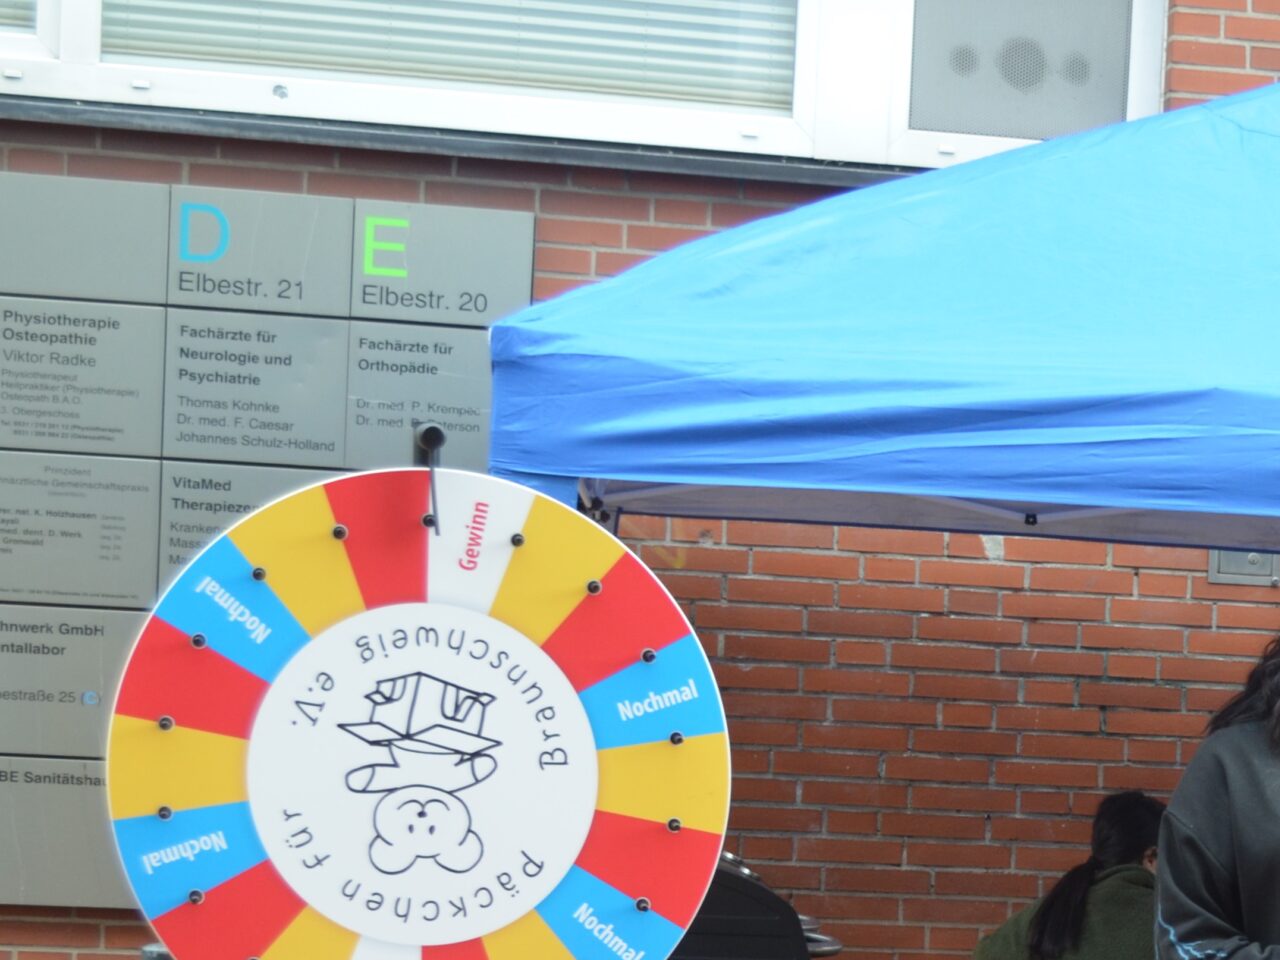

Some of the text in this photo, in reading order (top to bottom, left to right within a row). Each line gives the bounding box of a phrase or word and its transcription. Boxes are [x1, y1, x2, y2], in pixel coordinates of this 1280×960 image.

[179, 201, 231, 263] D
[363, 215, 410, 278] E
[178, 270, 304, 301] Elbestr. 21
[361, 284, 488, 313] Elbestr. 20
[2, 309, 121, 330] Physiotherapie
[2, 327, 98, 346] Osteopathie
[179, 324, 278, 344] Fachärzte für
[358, 337, 455, 355] Fachärzte für
[2, 349, 97, 367] Viktor Radke
[178, 347, 293, 366] Neurologie und
[358, 358, 439, 376] Orthopädie
[178, 368, 261, 386] Psychiatrie
[177, 394, 280, 413] Thomas Kohnke
[356, 398, 374, 410] Dr.
[377, 400, 407, 412] med.
[176, 412, 294, 432] Dr. med. F. Caesar
[355, 414, 374, 426] Dr.
[175, 431, 336, 453] Johannes Schulz-Holland
[51, 478, 149, 492] Gemeinschaftspraxis
[172, 476, 232, 491] VitaMed
[458, 501, 490, 571] Gewinn
[195, 576, 272, 644] Nochmal
[58, 622, 105, 637] GmbH
[58, 690, 76, 704] 25
[617, 678, 699, 722] Nochmal
[282, 625, 569, 923] Päckchen für Braunschweig e.V.
[142, 830, 229, 875] Nochmal
